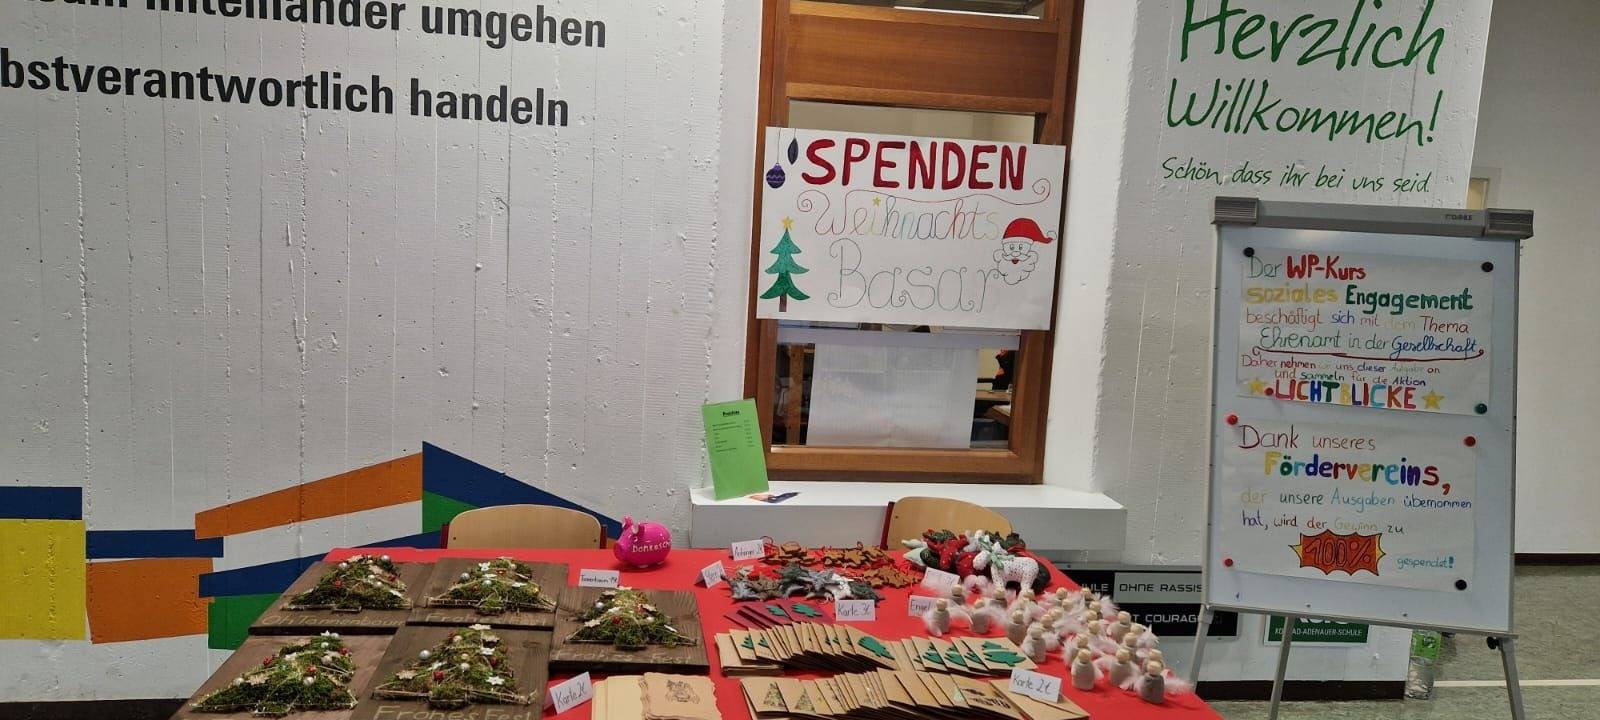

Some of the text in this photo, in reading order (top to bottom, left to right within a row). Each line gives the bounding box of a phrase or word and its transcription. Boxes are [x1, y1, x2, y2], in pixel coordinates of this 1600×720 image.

[421, 5, 607, 49] umgehen
[1179, 0, 1445, 74] Herzlich
[409, 77, 570, 127] handeln
[1166, 78, 1444, 147] Willkommen!
[801, 137, 1027, 190] SPENDEN
[1161, 156, 1431, 194] Schön, dass ihr bei uns seid.
[798, 190, 1000, 241] Weihnachts
[827, 238, 1008, 314] Basar
[1247, 254, 1366, 281] Der WP-Kurs
[1246, 283, 1474, 316] soziales Engagement
[1246, 307, 1322, 333] beschäftigt
[1330, 310, 1355, 325] sich
[1360, 313, 1380, 327] mit
[1421, 316, 1469, 334] Thema
[1260, 326, 1477, 360] Ehrenamt in der Gesellschaft
[1241, 355, 1278, 368] Daher
[1280, 356, 1317, 370] nehmen
[1335, 362, 1354, 371] uns
[1426, 366, 1441, 374] an
[1274, 367, 1296, 380] und
[1299, 370, 1345, 382] sammeln
[1352, 371, 1367, 382] für
[1391, 376, 1427, 387] Aktion
[1238, 424, 1377, 452] Dank unseres
[1263, 451, 1452, 496] Fördervereins,
[1240, 486, 1472, 513] der unsere Ausgaben übernommen
[1241, 510, 1405, 535] hat, wird der Gewinn zu
[1304, 539, 1373, 569] 100%
[1396, 555, 1455, 570] gespendet!
[1119, 583, 1155, 592] OHNE
[838, 602, 860, 617] Karte
[1145, 614, 1200, 623] COURAG
[1274, 627, 1363, 637] KOAD-ADENAUER-SCHULE
[1013, 673, 1034, 690] Karte
[555, 690, 578, 710] Karte
